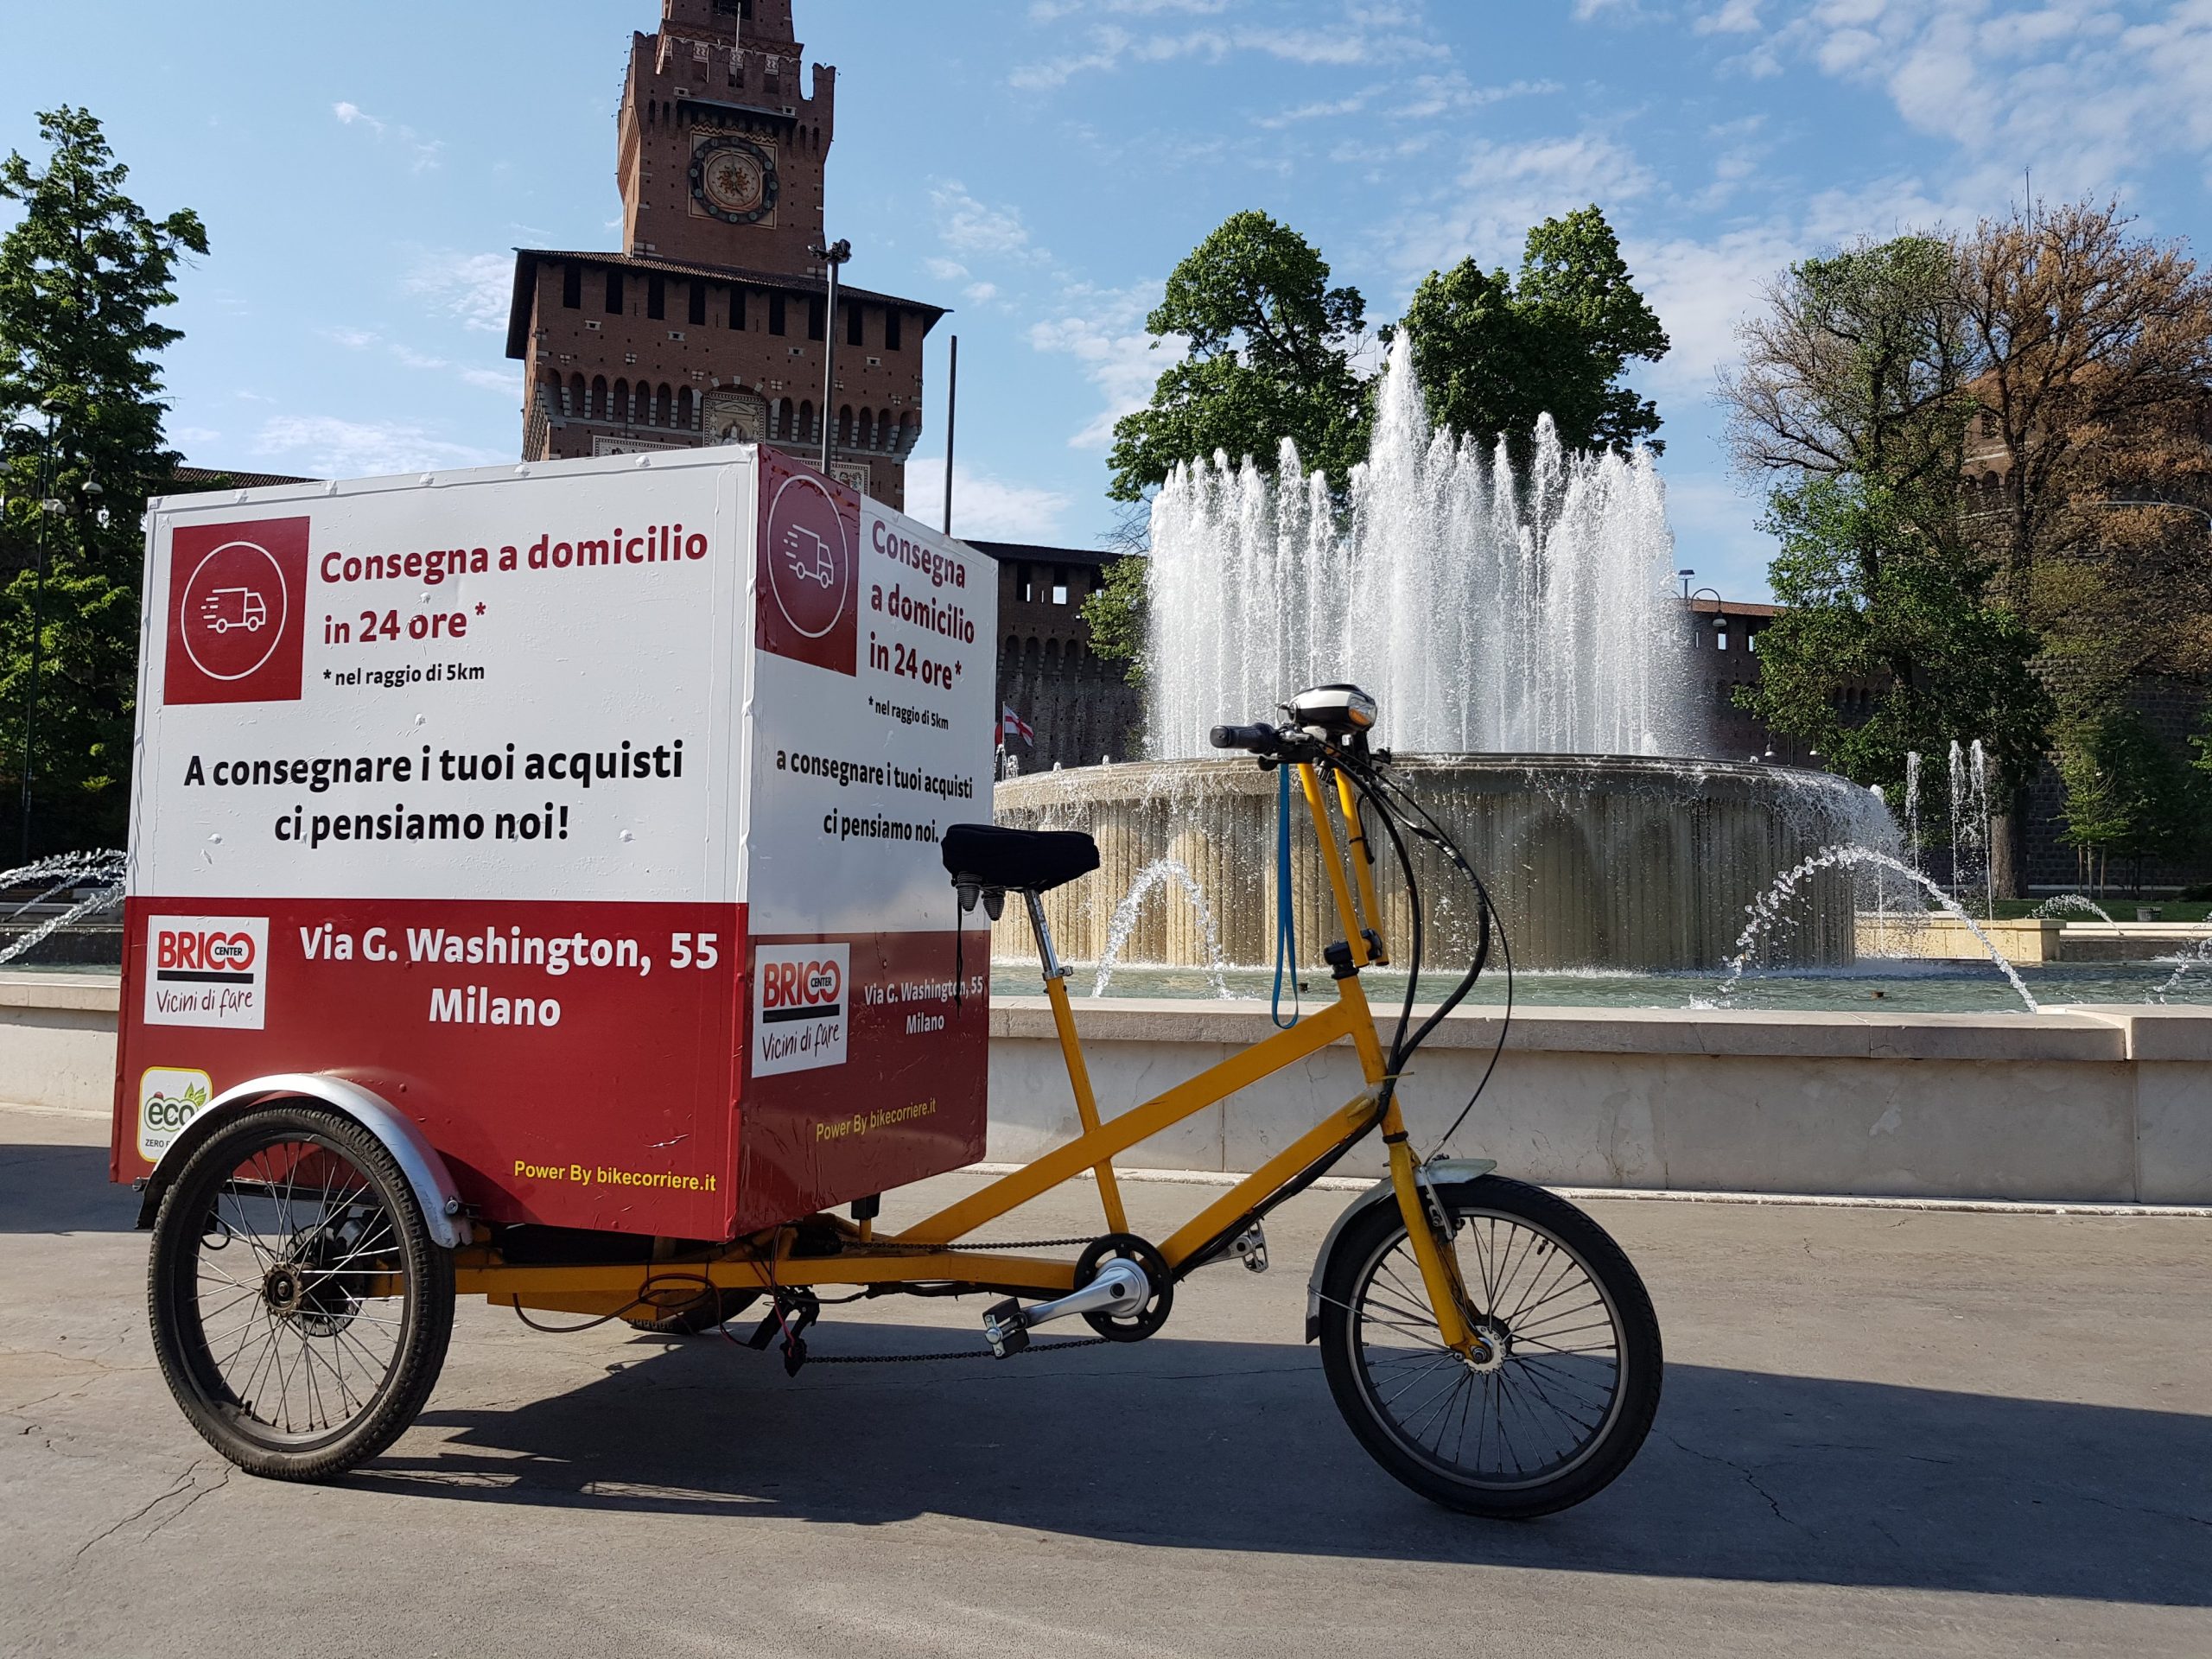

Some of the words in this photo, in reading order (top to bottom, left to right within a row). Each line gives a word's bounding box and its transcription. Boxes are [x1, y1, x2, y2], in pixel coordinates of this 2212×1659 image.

[321, 548, 487, 585] Consegna
[499, 546, 517, 571] a
[529, 524, 707, 569] domicilio
[872, 520, 966, 588] Consegna
[325, 615, 349, 644] in
[359, 610, 400, 642] 24
[871, 585, 882, 612] a
[888, 582, 975, 644] domicilio
[870, 632, 888, 671] in
[895, 644, 918, 679] 24
[366, 664, 421, 688] raggio
[426, 664, 442, 681] di
[447, 663, 484, 680] 5km
[892, 706, 919, 724] raggio
[922, 710, 929, 725] di
[931, 713, 948, 729] 5km
[184, 756, 205, 785] A
[213, 757, 411, 792] consegnare
[423, 745, 430, 780] i
[440, 743, 514, 780] tuoi
[525, 740, 683, 788] acquisti
[777, 751, 785, 770] a
[791, 753, 883, 786] consegnare
[887, 761, 892, 787] i
[894, 767, 921, 791] tuoi
[925, 774, 972, 800] acquisti
[276, 805, 302, 841] ci
[311, 804, 484, 849] pensiamo
[496, 802, 568, 839] noi!
[824, 808, 837, 834] ci
[842, 813, 912, 841] pensiamo
[916, 819, 938, 842] noi.
[158, 931, 256, 971] BRICO
[214, 947, 243, 956] CENTER
[300, 924, 353, 960] Via
[363, 927, 397, 961] G.
[407, 926, 651, 976] Washington,
[671, 933, 717, 969] 55
[763, 960, 842, 1007] BRICO
[810, 976, 832, 988] CENTER
[864, 982, 884, 1006] Via
[887, 983, 899, 1003] G.
[970, 976, 984, 995] 55
[156, 989, 198, 1013] Vicini
[201, 988, 215, 1011] di
[219, 988, 253, 1018] fare
[429, 986, 560, 1027] Milano
[762, 1031, 798, 1062] Vicini
[800, 1026, 812, 1052] di
[814, 1023, 840, 1058] fare
[906, 1012, 945, 1035] Milano
[148, 1103, 194, 1127] eco
[817, 1121, 851, 1141] Power
[854, 1115, 867, 1135] By
[870, 1098, 936, 1128] bikecorriere.it
[145, 1138, 164, 1147] ZERO
[515, 1160, 565, 1179] Power
[570, 1165, 591, 1185] By
[597, 1166, 715, 1191] bikecorriere.it
